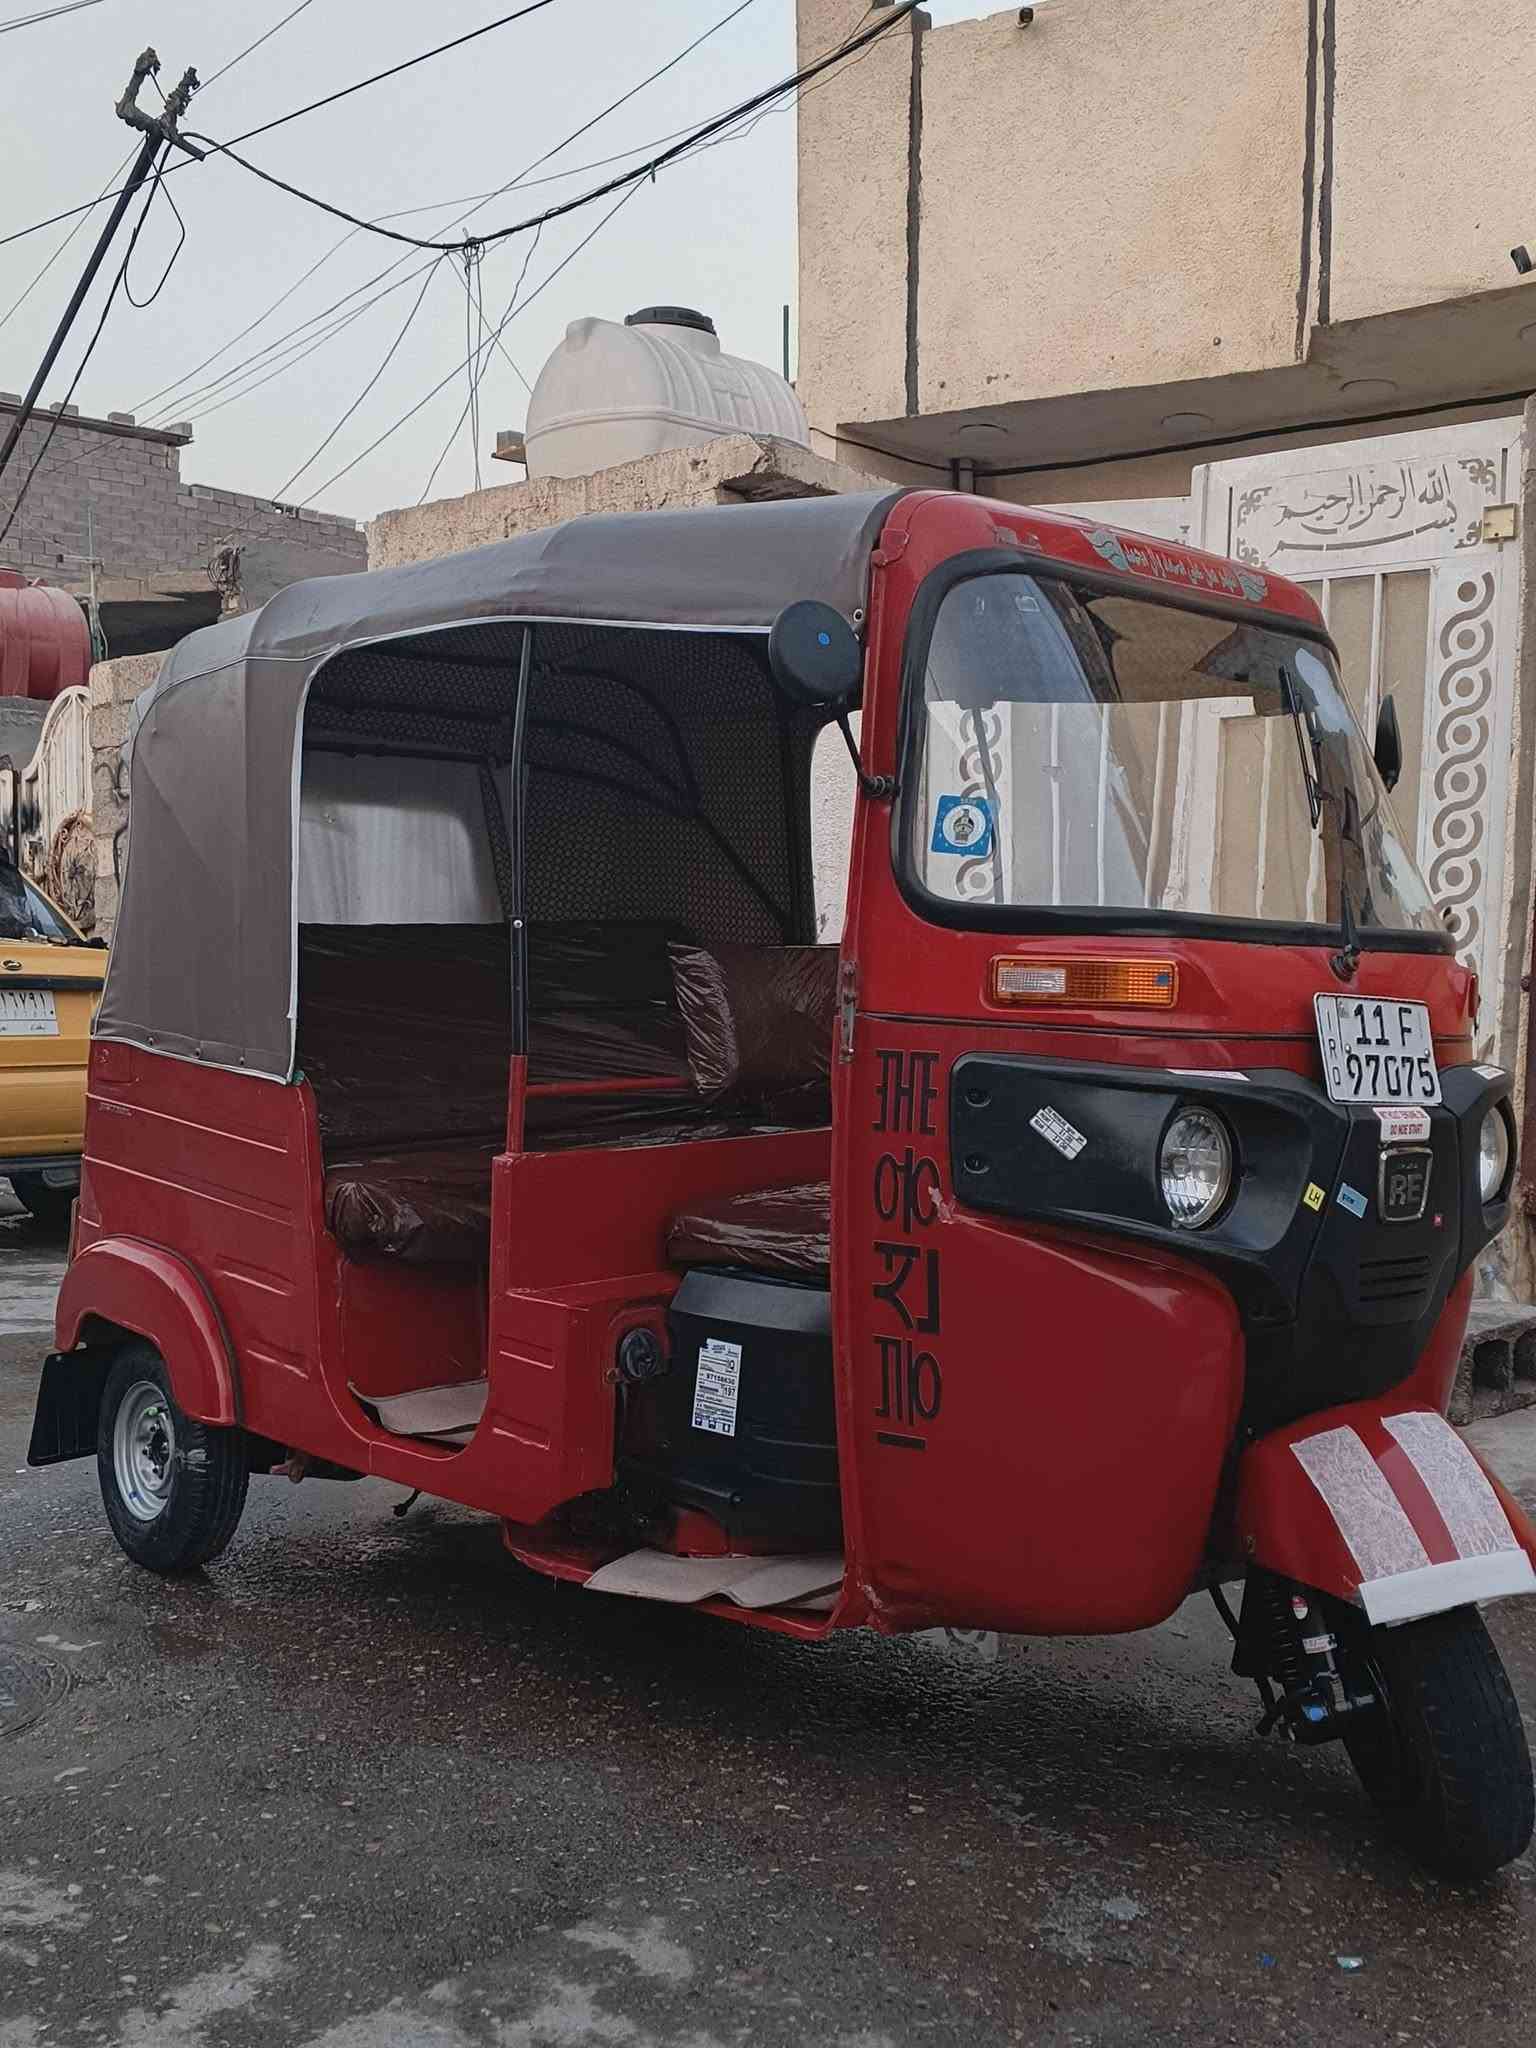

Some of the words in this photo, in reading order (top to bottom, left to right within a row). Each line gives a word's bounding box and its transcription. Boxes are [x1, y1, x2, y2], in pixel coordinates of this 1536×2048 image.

[1272, 471, 1364, 528] الرحيم
[1300, 462, 1416, 536] الرحمن
[1417, 463, 1451, 505] الله
[1354, 1003, 1390, 1046] 11
[1398, 1006, 1413, 1047] F
[1346, 1053, 1436, 1098] 97075
[1388, 1174, 1424, 1206] RE
